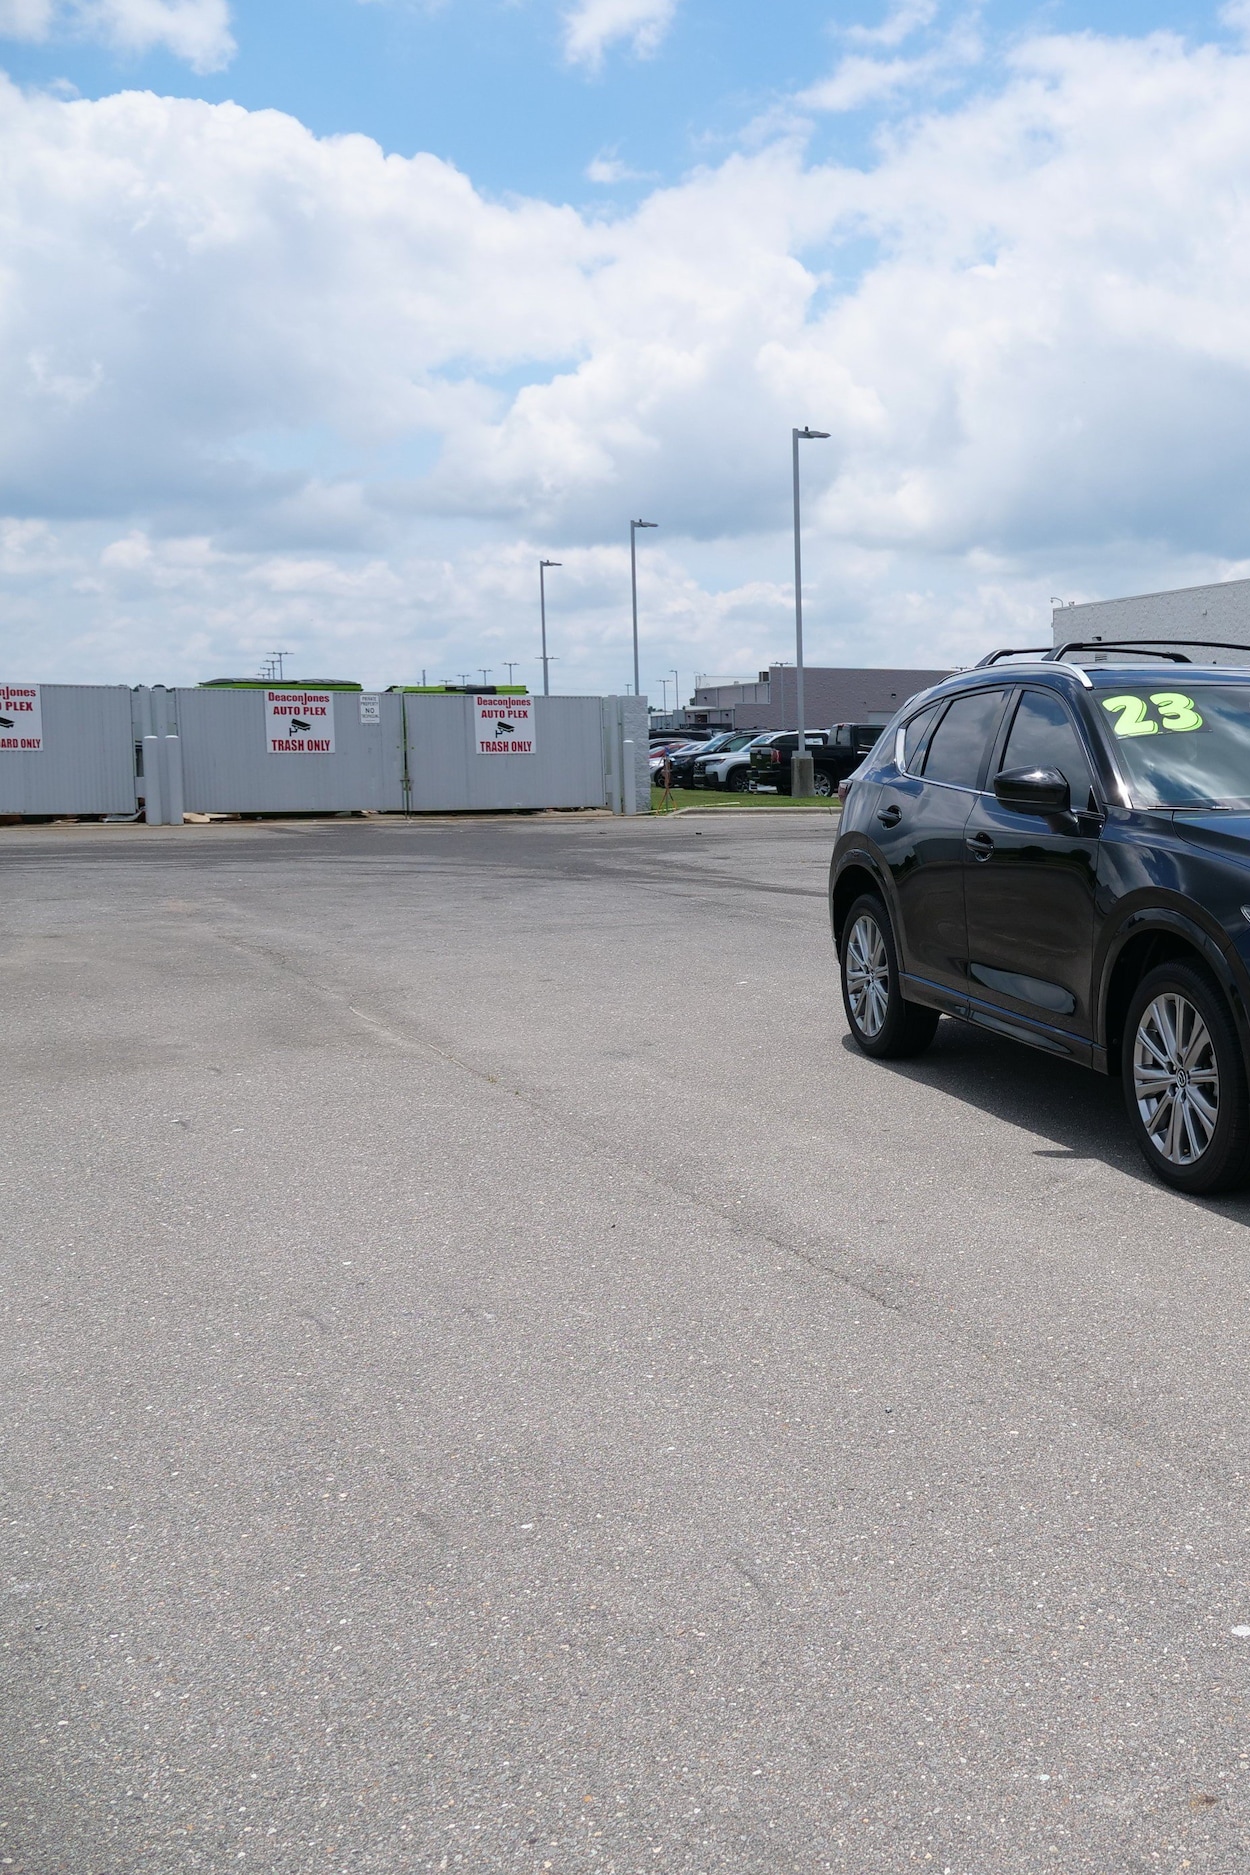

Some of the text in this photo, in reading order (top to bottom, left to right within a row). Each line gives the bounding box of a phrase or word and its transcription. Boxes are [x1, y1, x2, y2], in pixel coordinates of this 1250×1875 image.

[5, 701, 33, 711] PLEX
[273, 706, 327, 716] AUTO PLEX
[481, 709, 528, 719] AUTO PLEX
[1102, 692, 1203, 736] 23
[20, 738, 41, 749] ONLY
[272, 739, 331, 752] TRASH ONLY
[480, 741, 532, 752] TRASH ONLY
